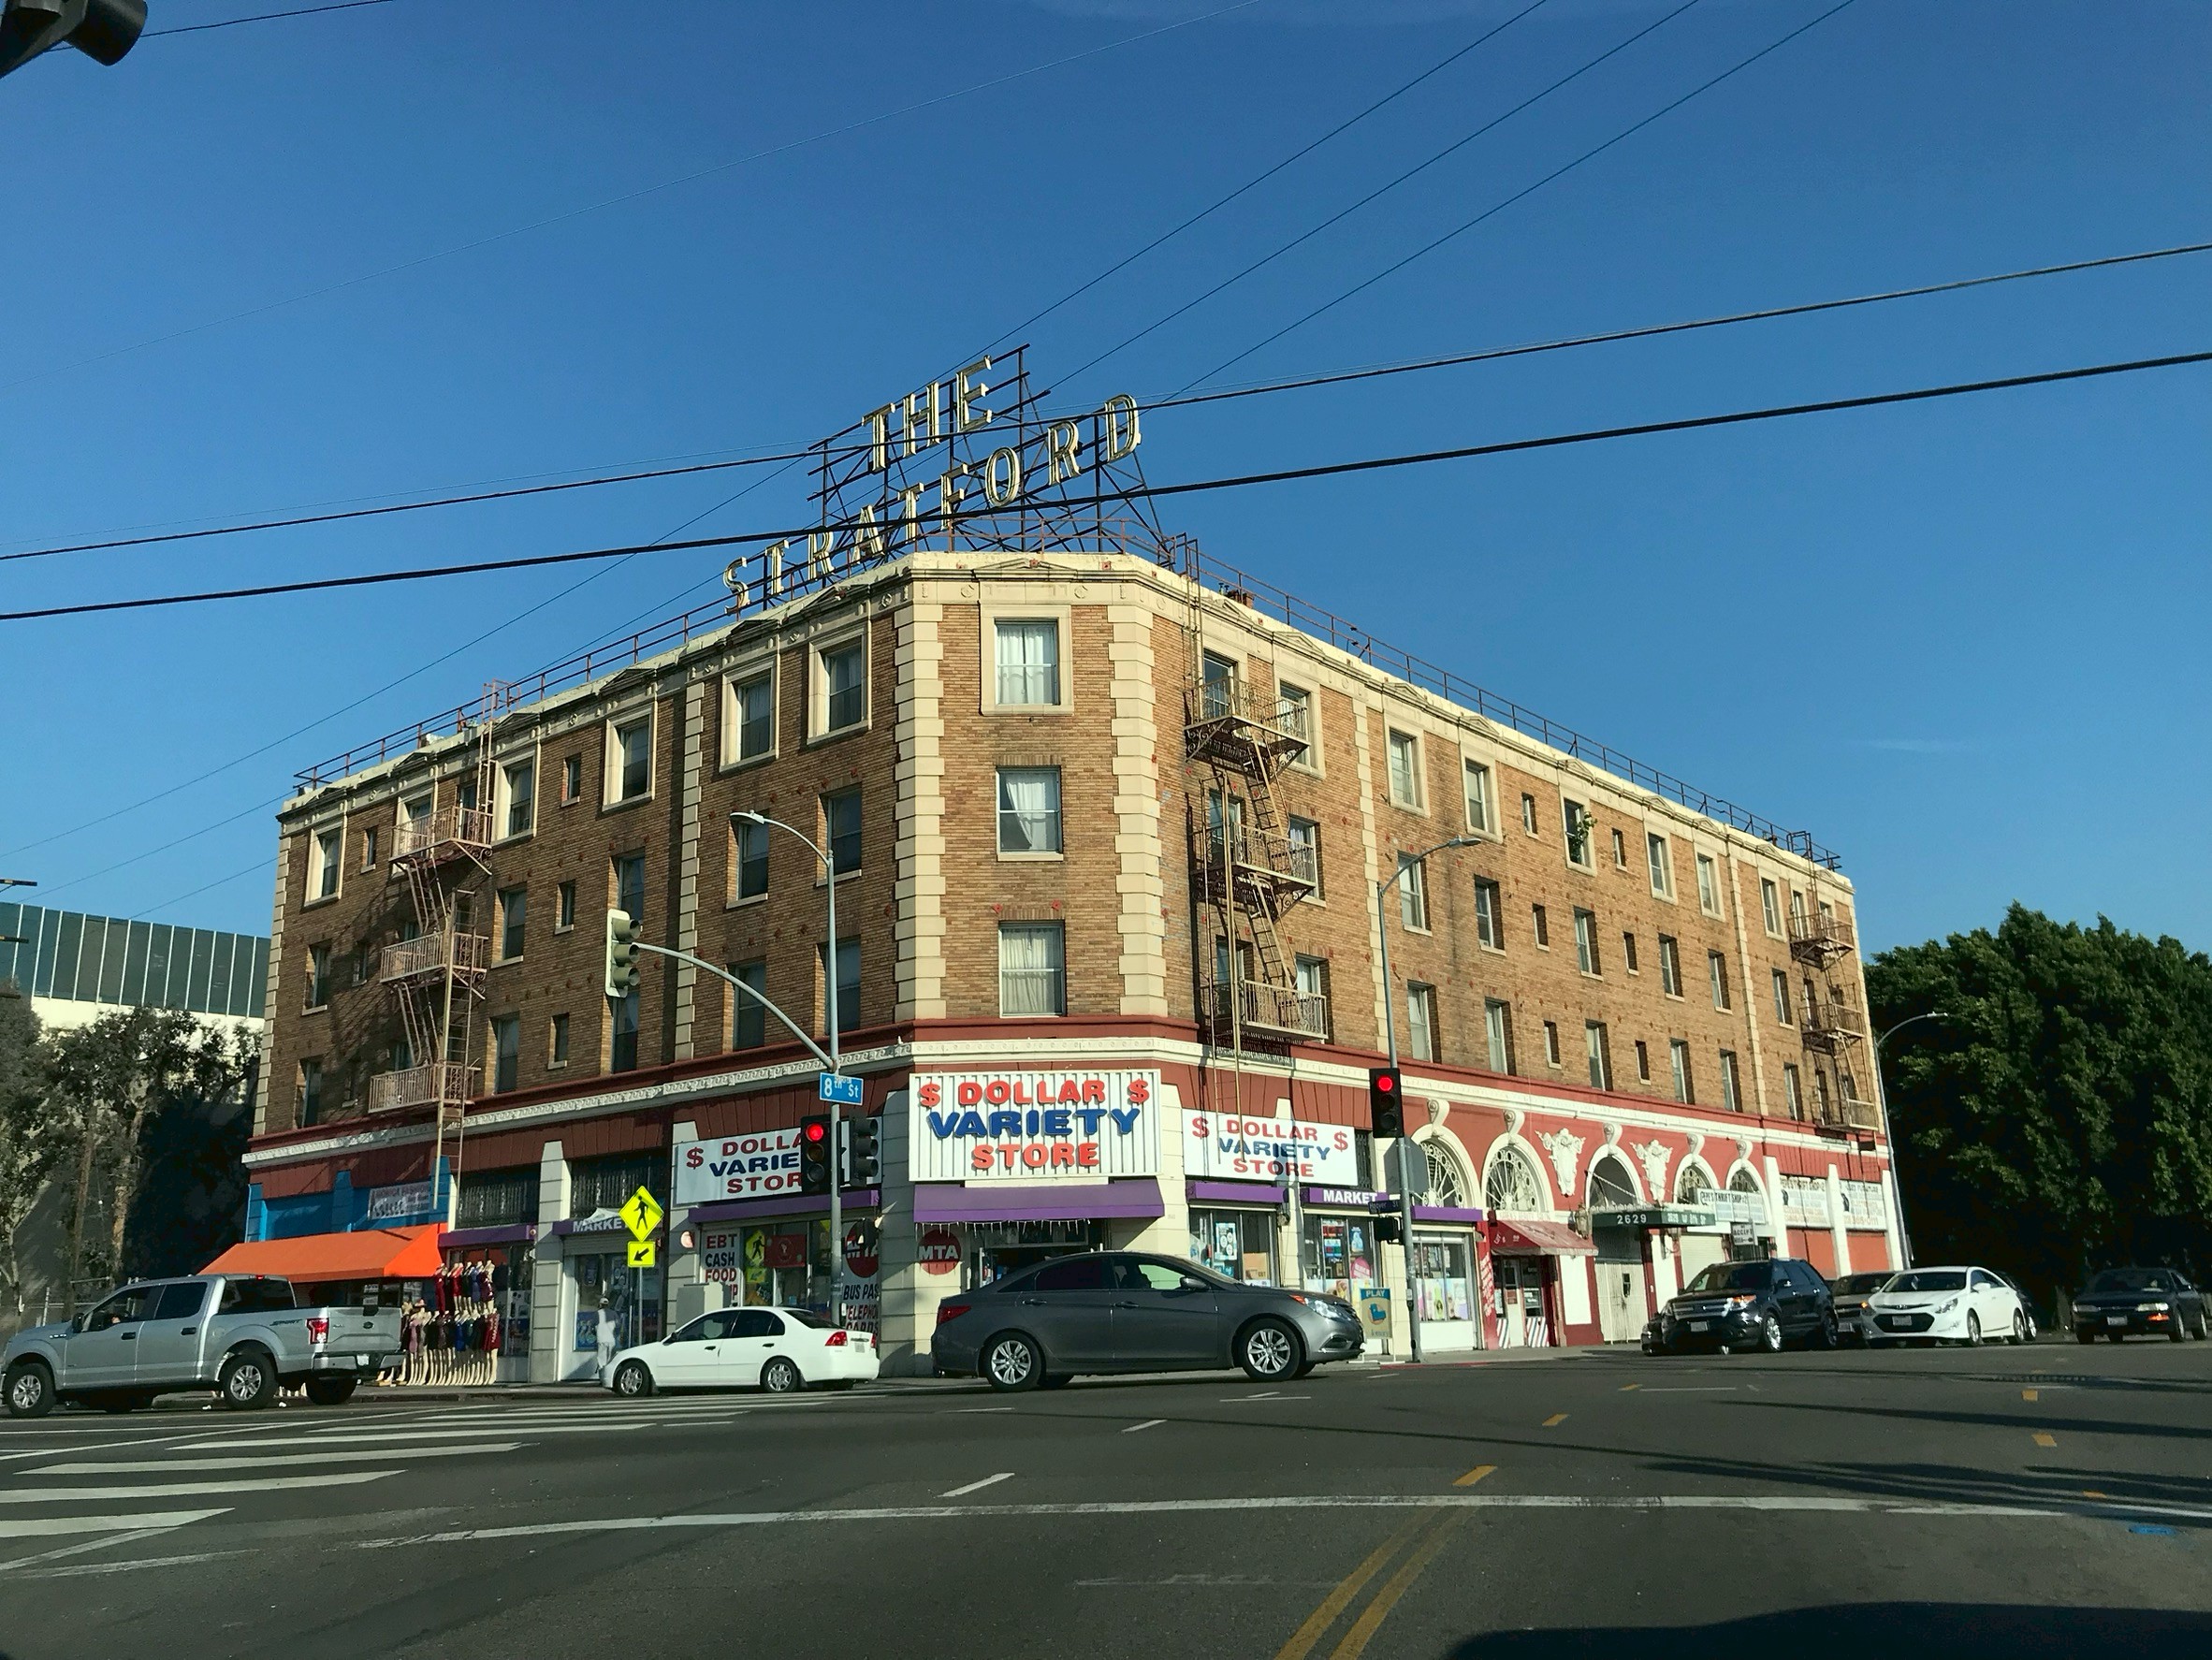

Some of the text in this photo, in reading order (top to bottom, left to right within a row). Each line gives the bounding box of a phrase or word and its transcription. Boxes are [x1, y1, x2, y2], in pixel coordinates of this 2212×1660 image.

[862, 355, 994, 472] THE
[722, 393, 1142, 616] STRATFORD
[848, 1084, 859, 1099] St
[920, 1079, 1150, 1107] $ DOLLAR $
[927, 1108, 1141, 1139] VARIETY
[1227, 1119, 1318, 1142] DOLLAR
[1333, 1131, 1348, 1152] $
[686, 1135, 801, 1169] $ DOLLA
[972, 1143, 1099, 1169] STORE
[1219, 1137, 1331, 1160] VARIETY
[709, 1152, 800, 1177] VARIE
[1233, 1158, 1315, 1177] STORE
[727, 1172, 802, 1194] STOR
[1323, 1188, 1378, 1204] MARKET
[573, 1217, 622, 1232] MARKE
[1617, 1214, 1647, 1225] 2629
[706, 1233, 737, 1249] EBT
[706, 1252, 735, 1268] CASH
[918, 1245, 958, 1260] MTA
[706, 1268, 737, 1283] FOOD
[843, 1284, 880, 1300] BUS PAS
